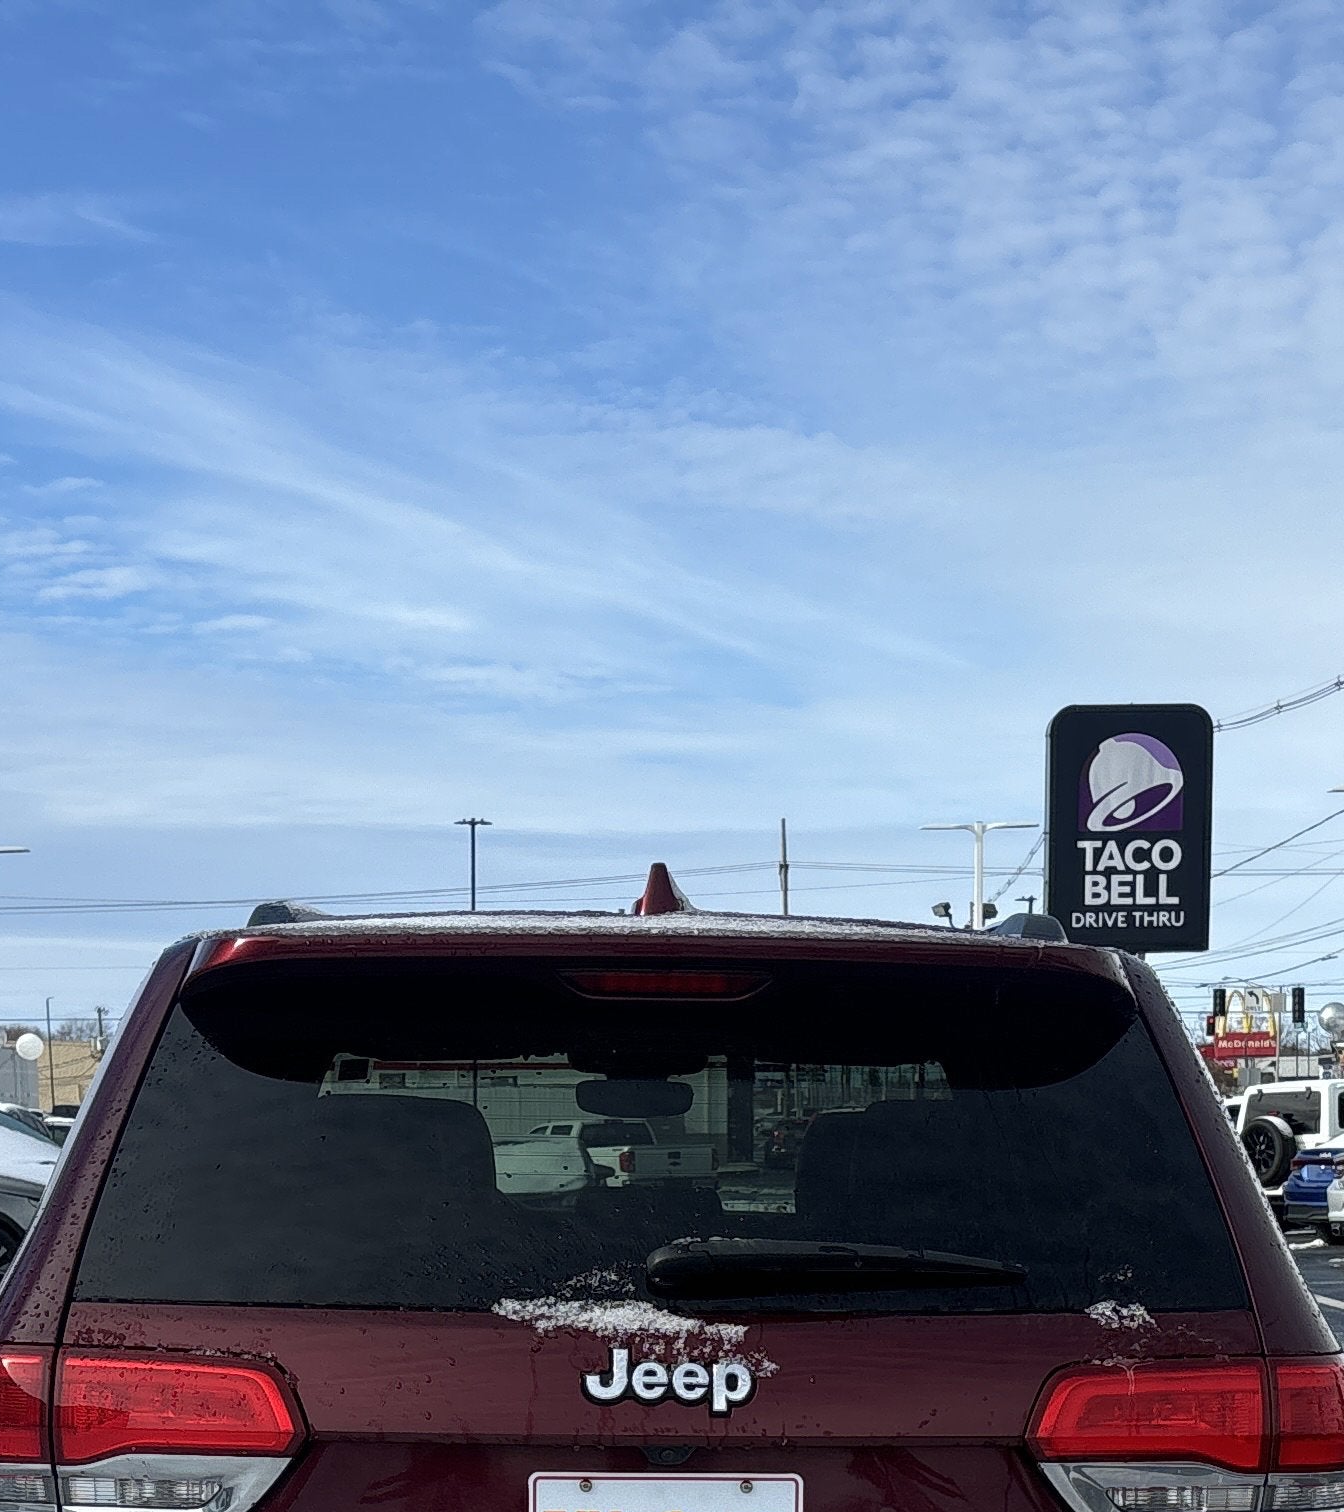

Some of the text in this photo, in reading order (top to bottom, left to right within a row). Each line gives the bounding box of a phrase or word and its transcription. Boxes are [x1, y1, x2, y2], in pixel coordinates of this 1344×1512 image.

[1076, 838, 1182, 872] TACO
[1084, 873, 1180, 906] BELL
[1071, 910, 1185, 928] DRIVE THRU
[582, 1347, 754, 1413] Jeep
